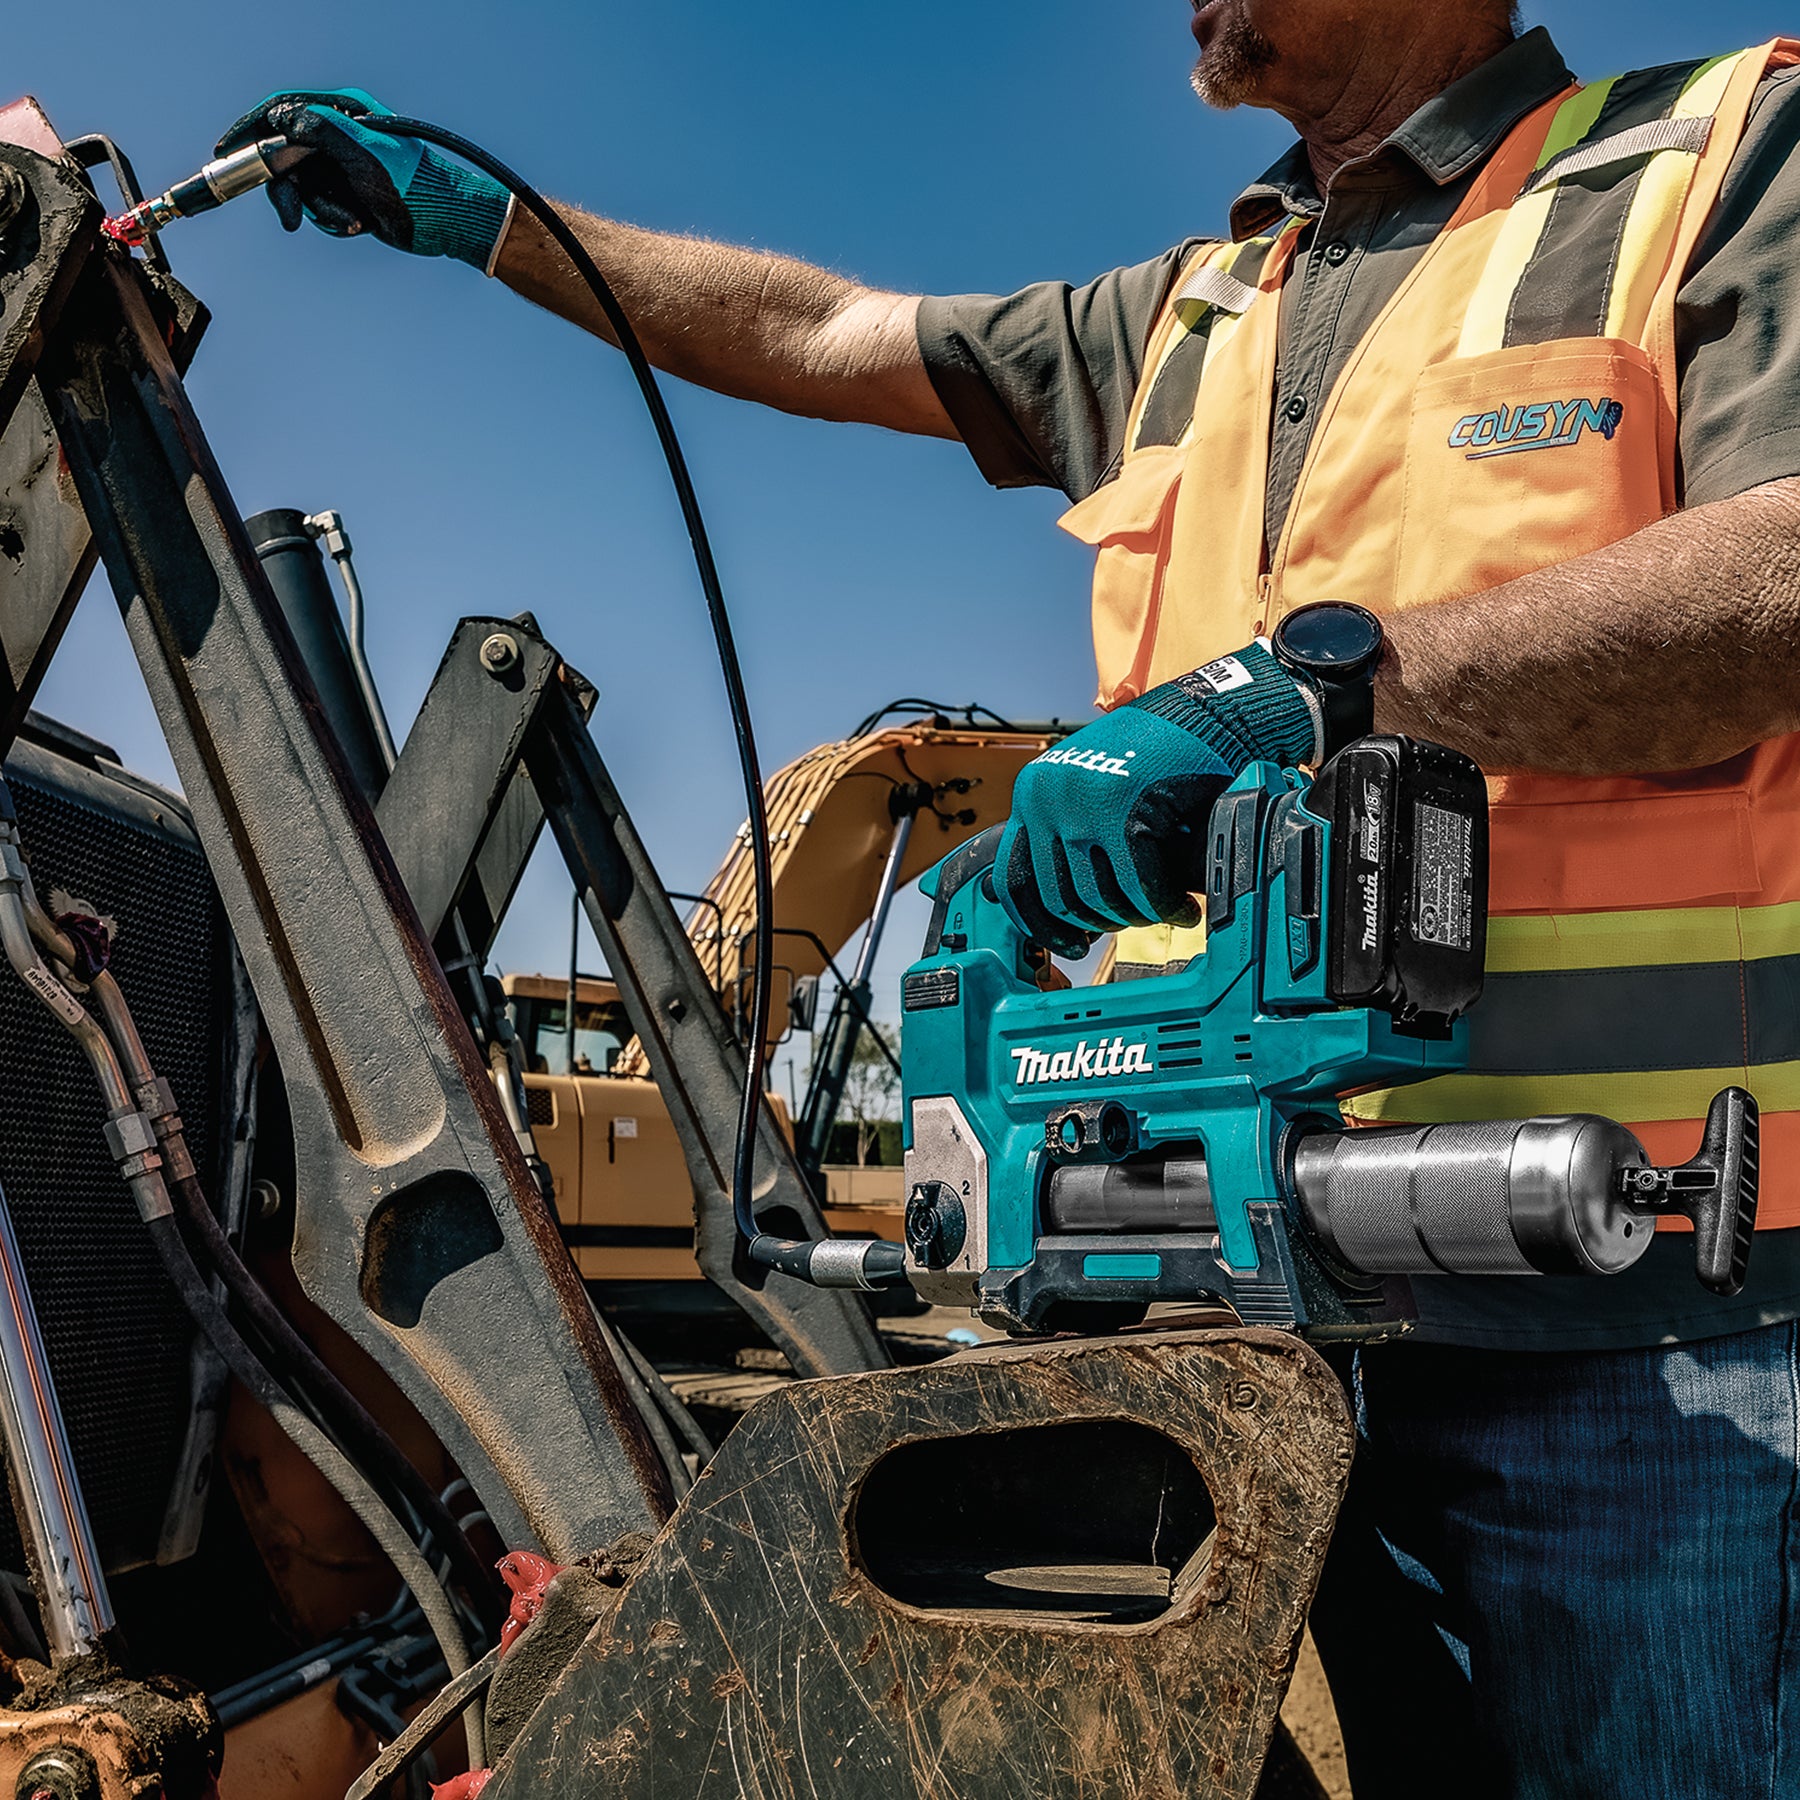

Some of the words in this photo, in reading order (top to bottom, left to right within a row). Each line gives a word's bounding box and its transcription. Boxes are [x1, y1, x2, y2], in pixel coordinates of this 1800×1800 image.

[1447, 397, 1611, 449] COUSYN
[962, 1180, 971, 1196] 2
[964, 1253, 971, 1271] 1
